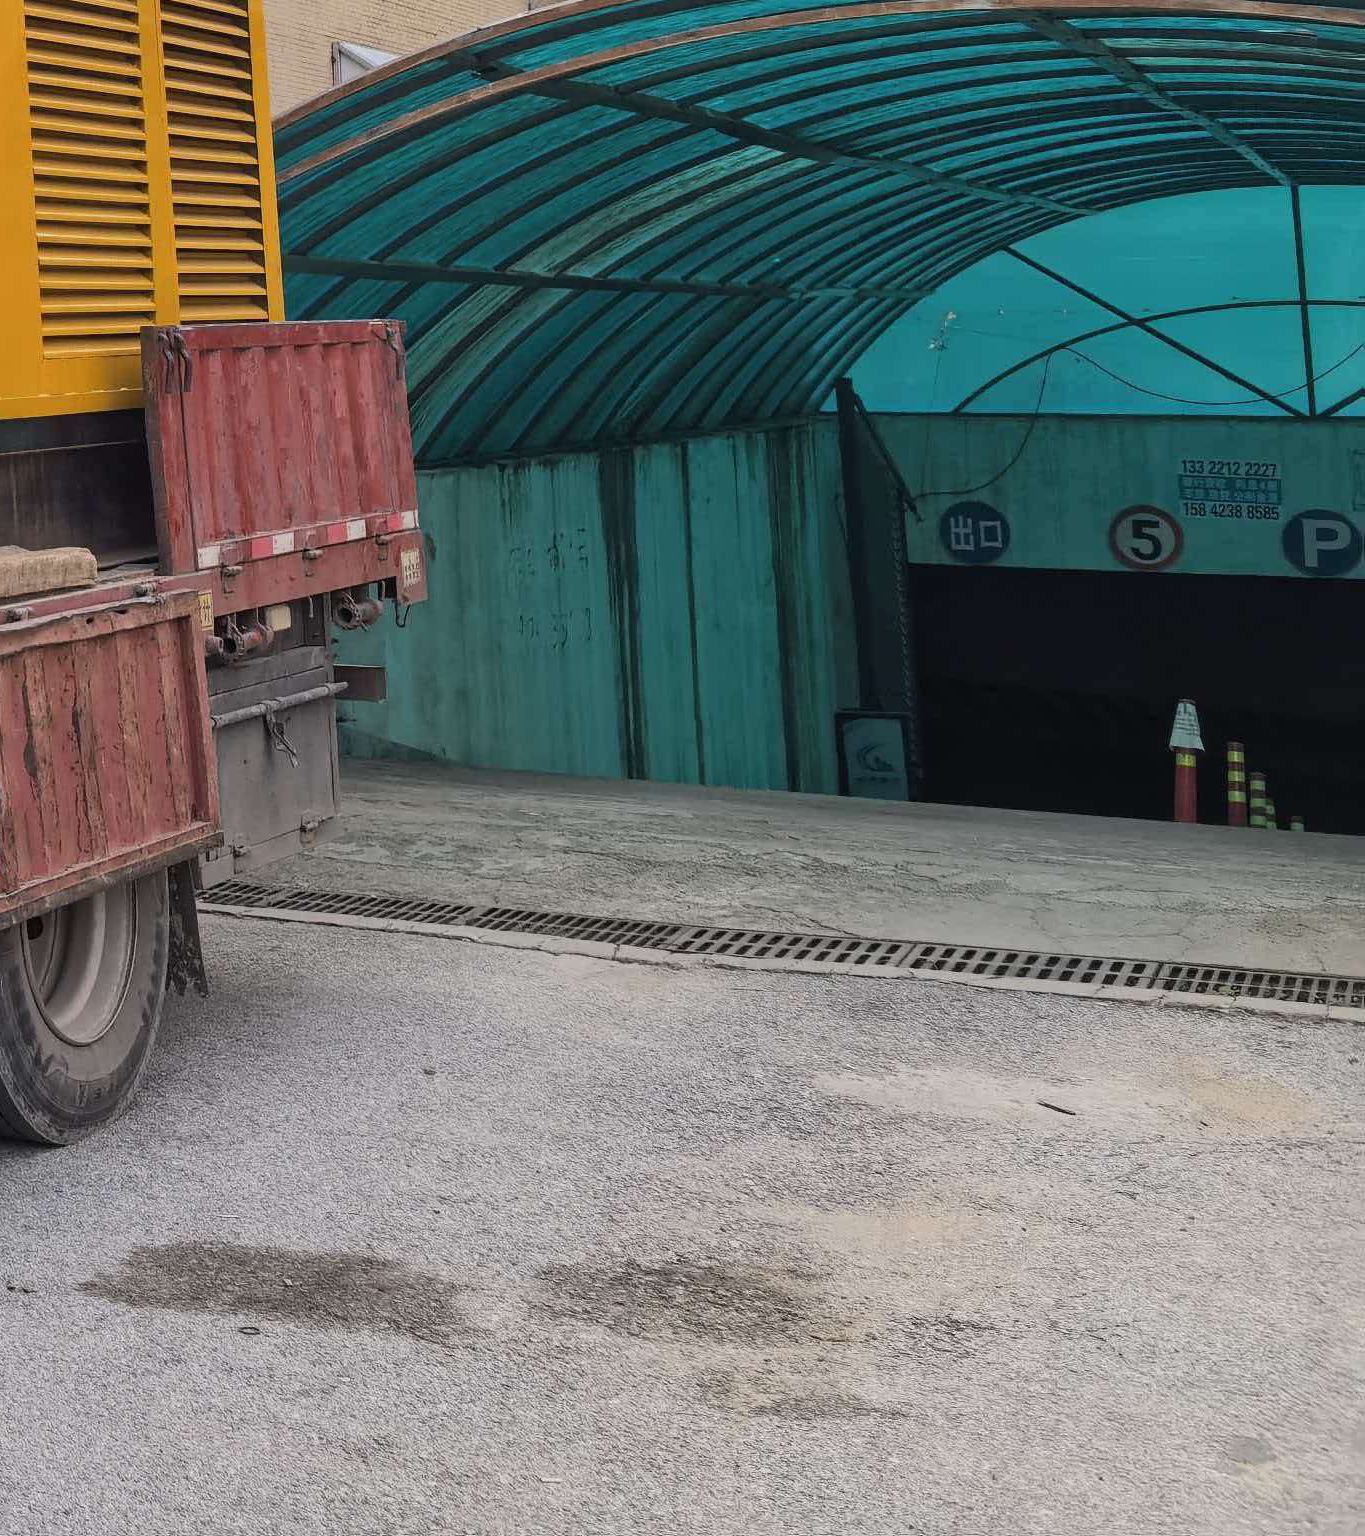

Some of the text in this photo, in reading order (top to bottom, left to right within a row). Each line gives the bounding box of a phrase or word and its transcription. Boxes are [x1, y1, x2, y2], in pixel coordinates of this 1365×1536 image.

[1181, 459, 1205, 474] 133
[950, 515, 1003, 552] 出口
[1131, 519, 1163, 561] 5
[1301, 518, 1352, 567] P
